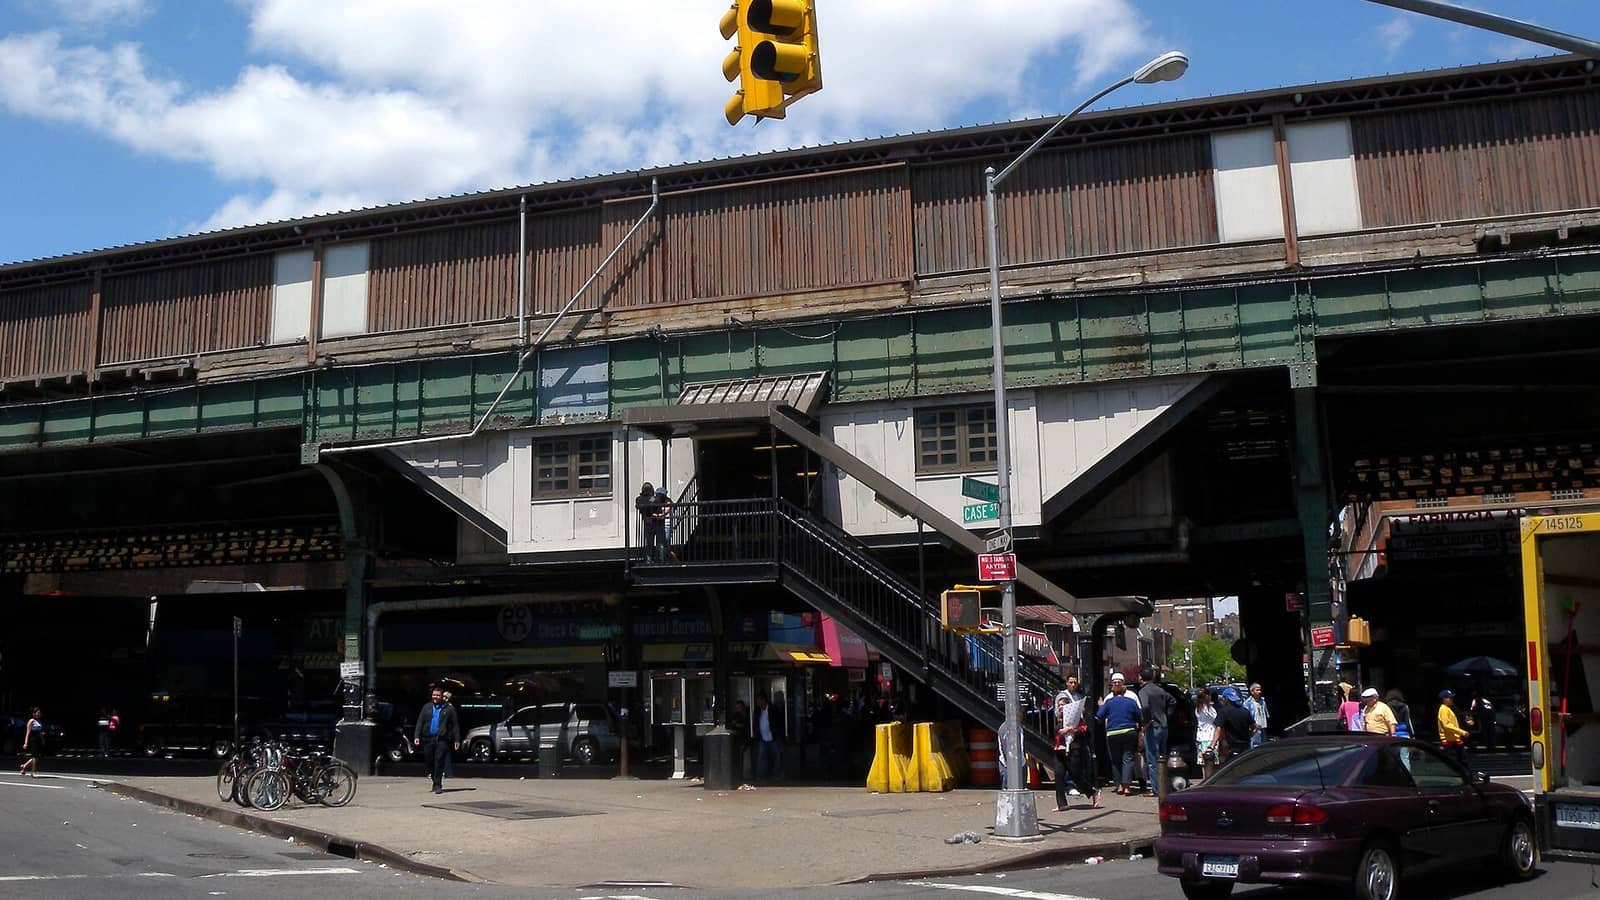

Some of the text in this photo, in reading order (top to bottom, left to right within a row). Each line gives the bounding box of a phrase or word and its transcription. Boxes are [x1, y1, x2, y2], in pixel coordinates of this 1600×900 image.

[964, 503, 997, 521] CASE ST
[1408, 511, 1494, 523] FARMACIA
[1546, 516, 1583, 530] 145125
